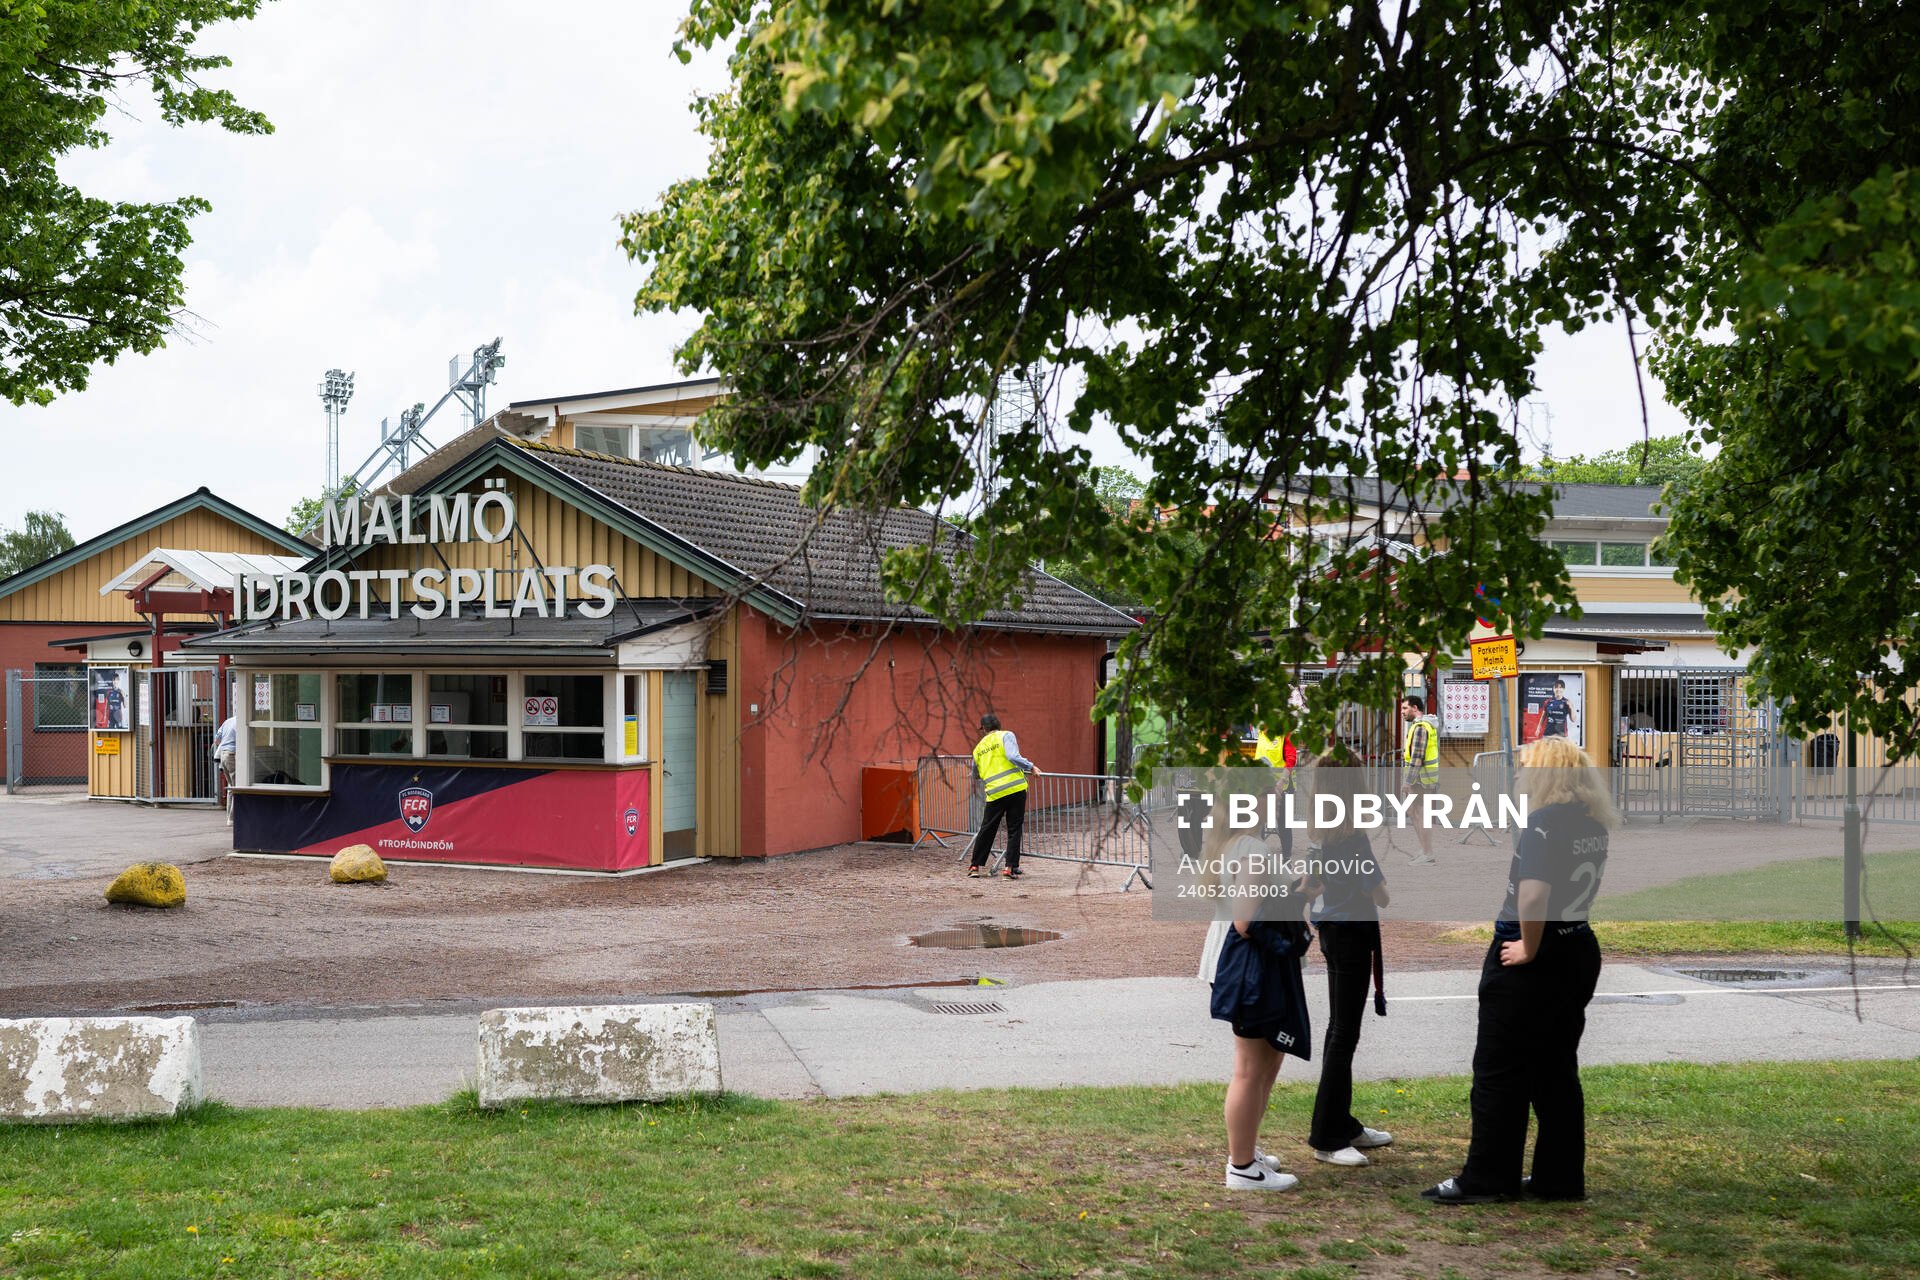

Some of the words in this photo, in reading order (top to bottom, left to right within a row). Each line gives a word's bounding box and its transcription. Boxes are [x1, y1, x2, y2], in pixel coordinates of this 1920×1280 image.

[323, 478, 516, 546] MALMÖ
[232, 563, 617, 621] IDROTTSPLATS
[1477, 644, 1509, 655] Parkering
[1483, 655, 1504, 665] Malmö
[403, 799, 428, 811] FCR
[626, 815, 637, 824] FCR
[378, 838, 454, 850] #TROPÅDINDRÖM
[1276, 1030, 1296, 1048] EH
